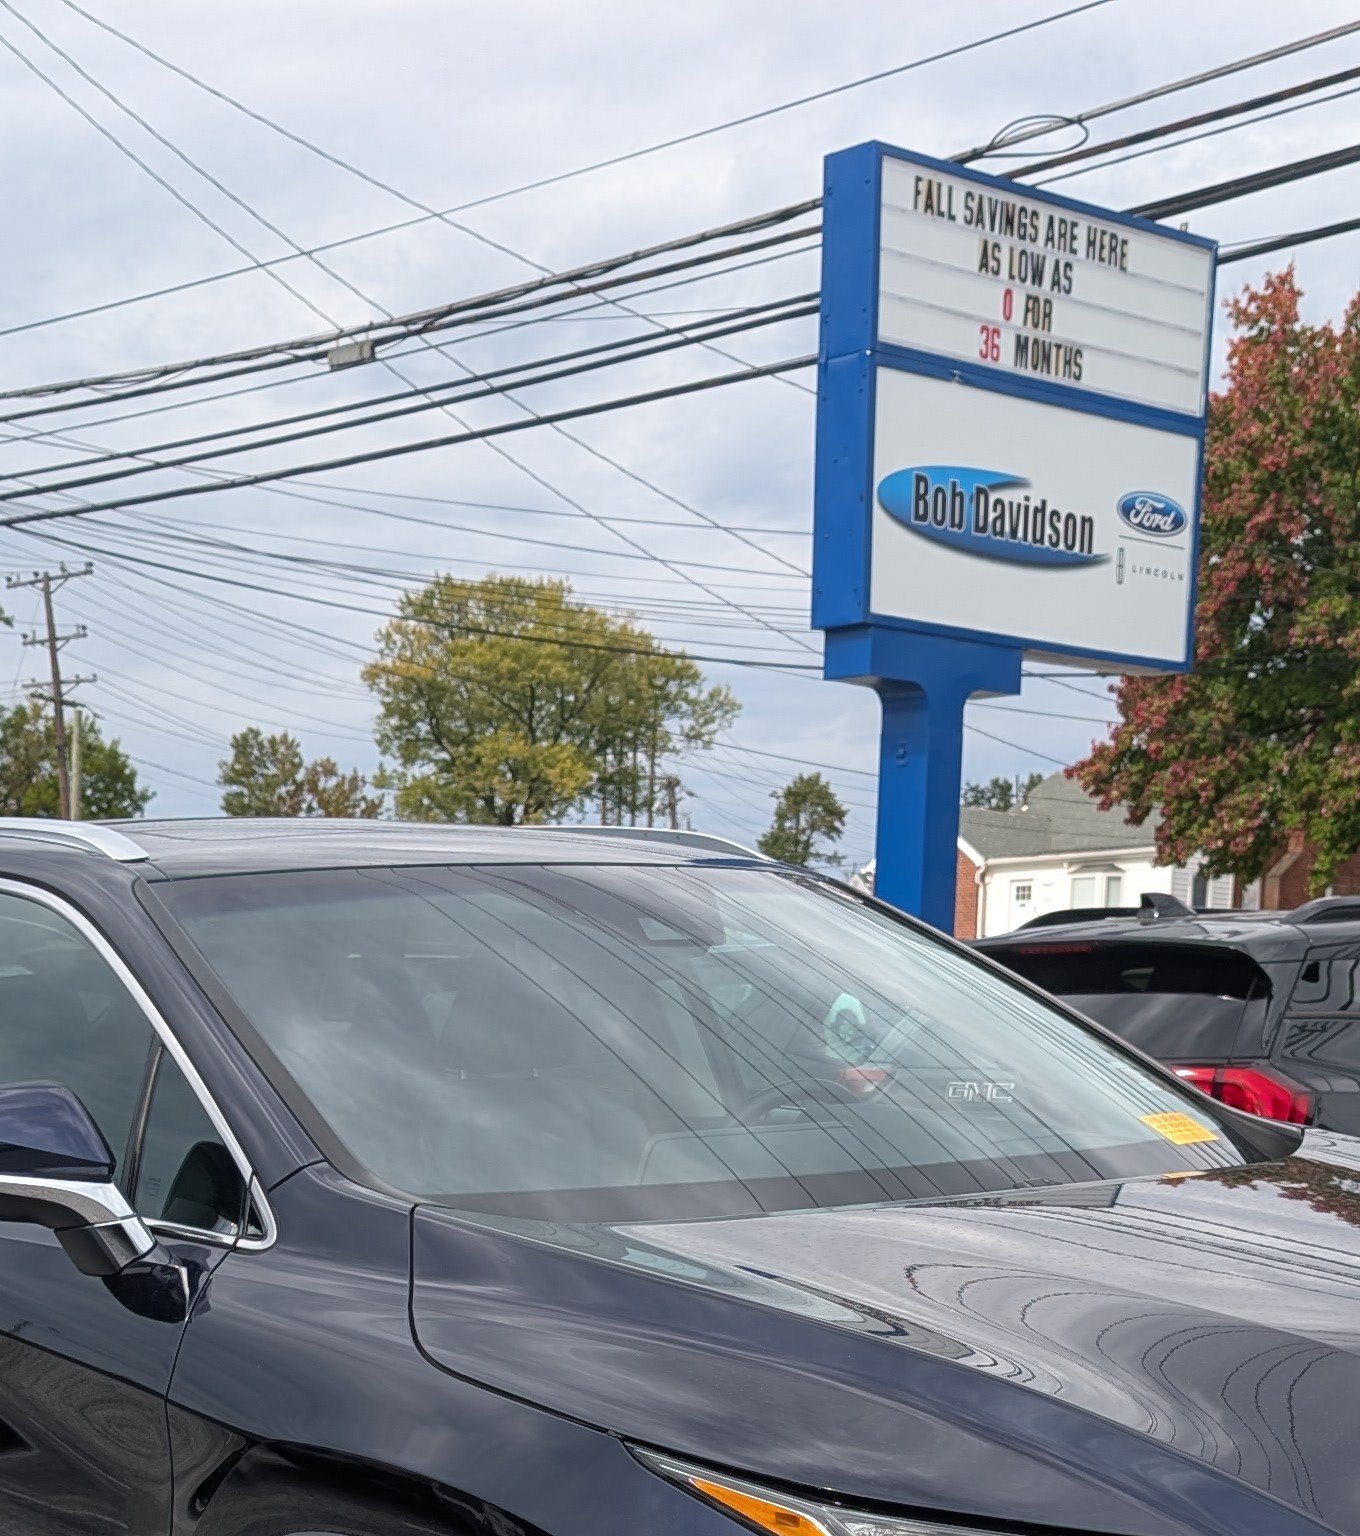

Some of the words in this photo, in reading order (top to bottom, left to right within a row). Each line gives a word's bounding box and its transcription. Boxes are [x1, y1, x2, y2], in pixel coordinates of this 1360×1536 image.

[914, 176, 956, 221] FALL
[963, 191, 1038, 243] SAVINGS
[1044, 215, 1078, 255] ARE
[1086, 225, 1129, 272] HERE
[978, 239, 1001, 276] AS
[1008, 247, 1046, 287] LOW
[1050, 259, 1072, 294] AS
[1003, 288, 1013, 321] 0
[1023, 294, 1053, 332] FOR
[978, 325, 1001, 362] 36
[1014, 333, 1083, 381] MONTHS
[913, 472, 965, 532] Bob
[973, 484, 1095, 555] Davidson
[1129, 496, 1177, 532] Ford
[1131, 564, 1184, 582] LINCOLN
[946, 1082, 1015, 1102] GMC
